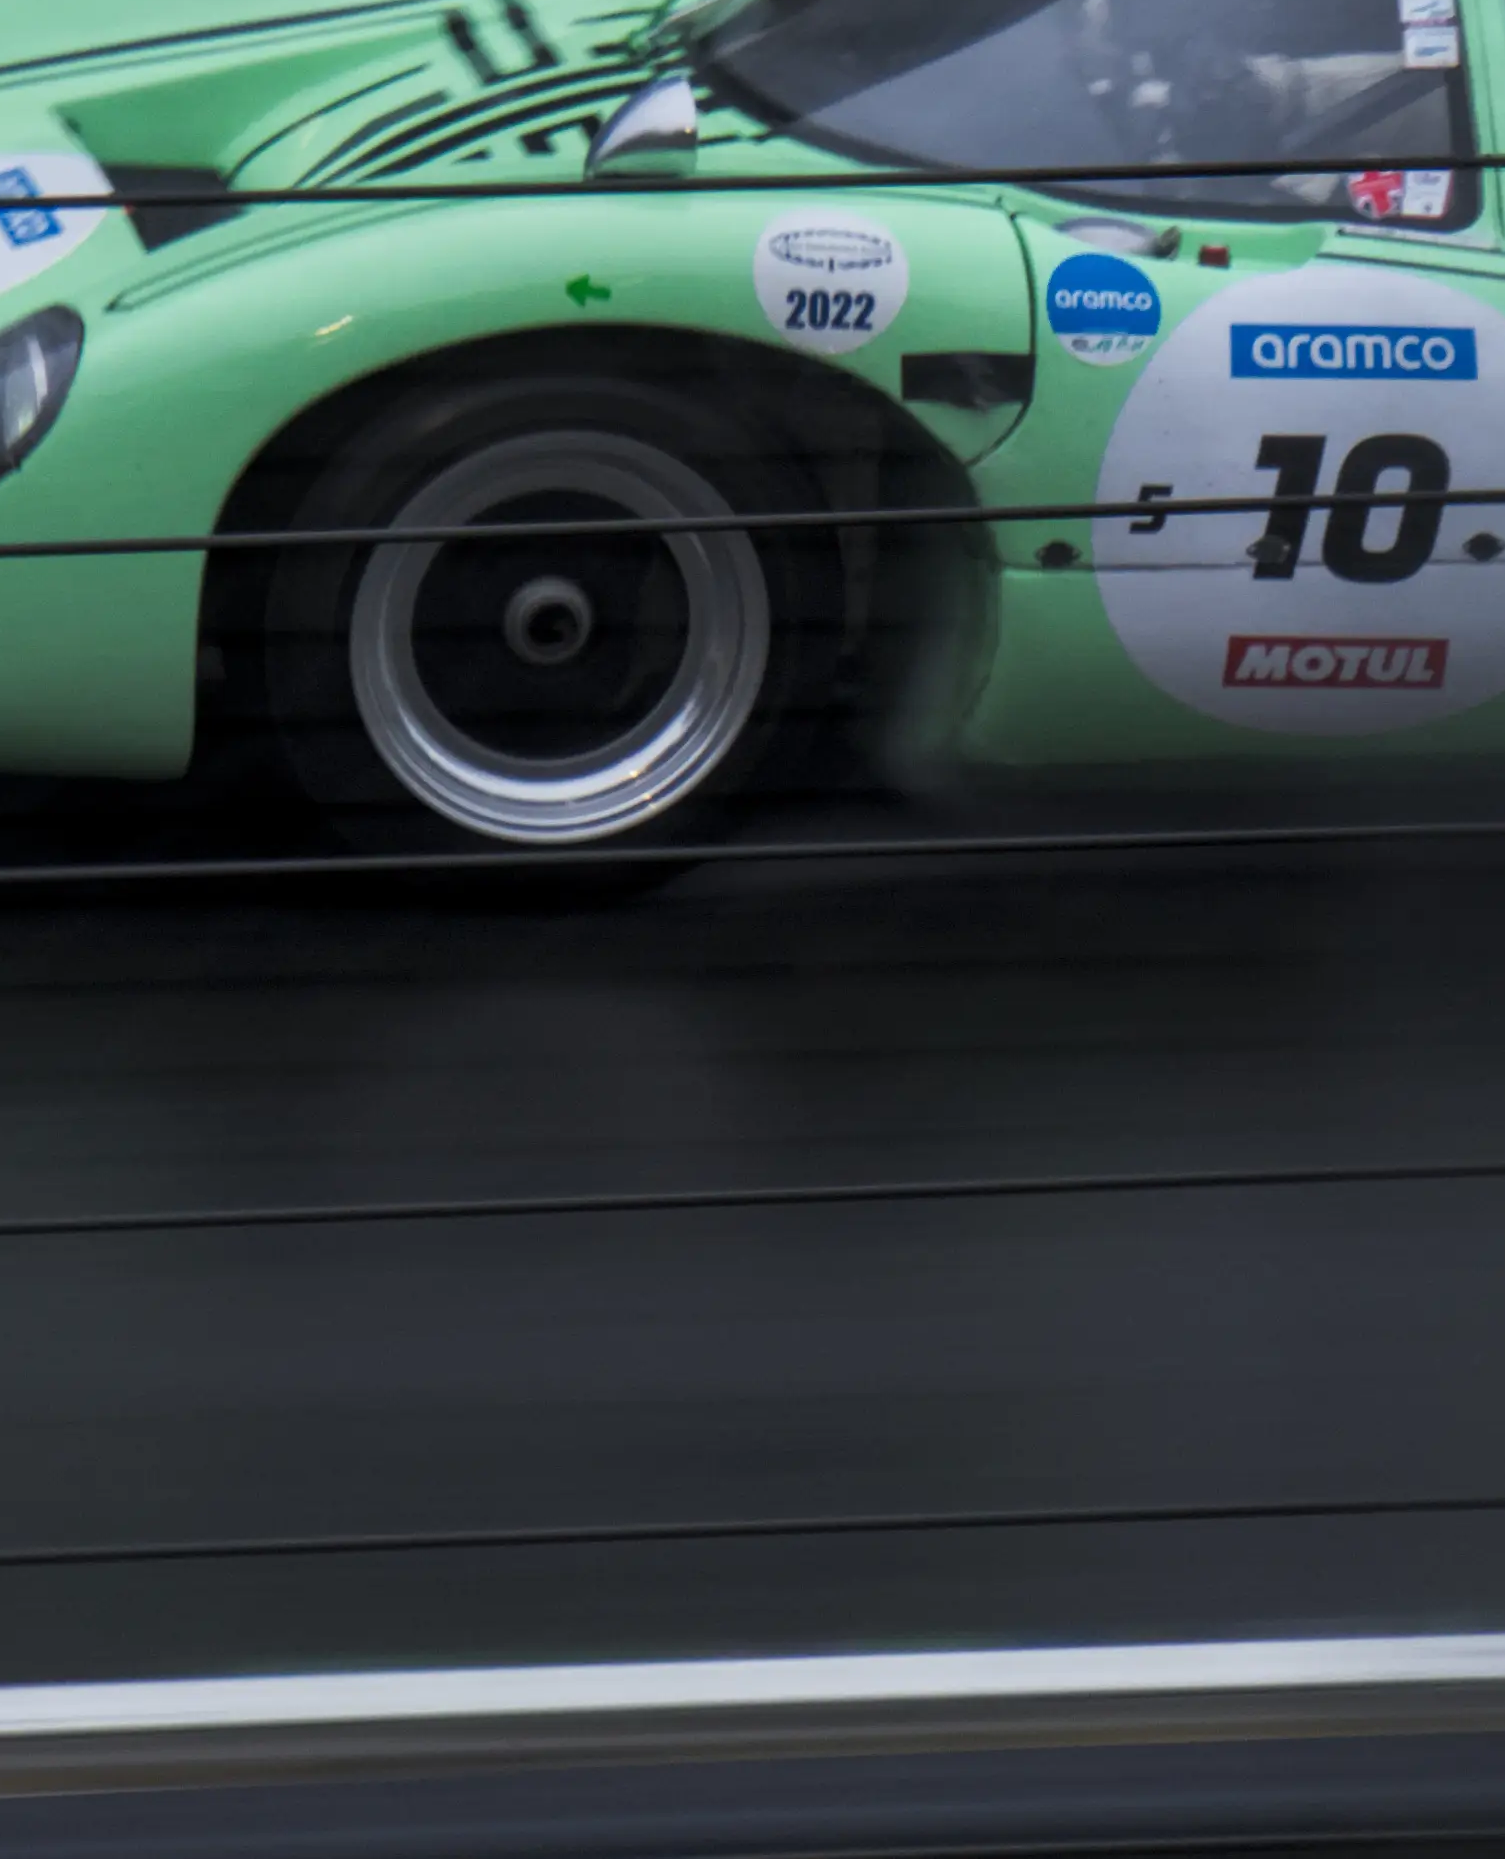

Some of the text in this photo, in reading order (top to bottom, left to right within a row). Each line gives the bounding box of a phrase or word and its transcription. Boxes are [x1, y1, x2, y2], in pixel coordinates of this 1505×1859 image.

[785, 289, 876, 331] 2022
[1054, 289, 1153, 311] aramco
[1251, 334, 1455, 371] aramco
[1252, 433, 1450, 584] 10
[1234, 645, 1436, 682] MOTUL
